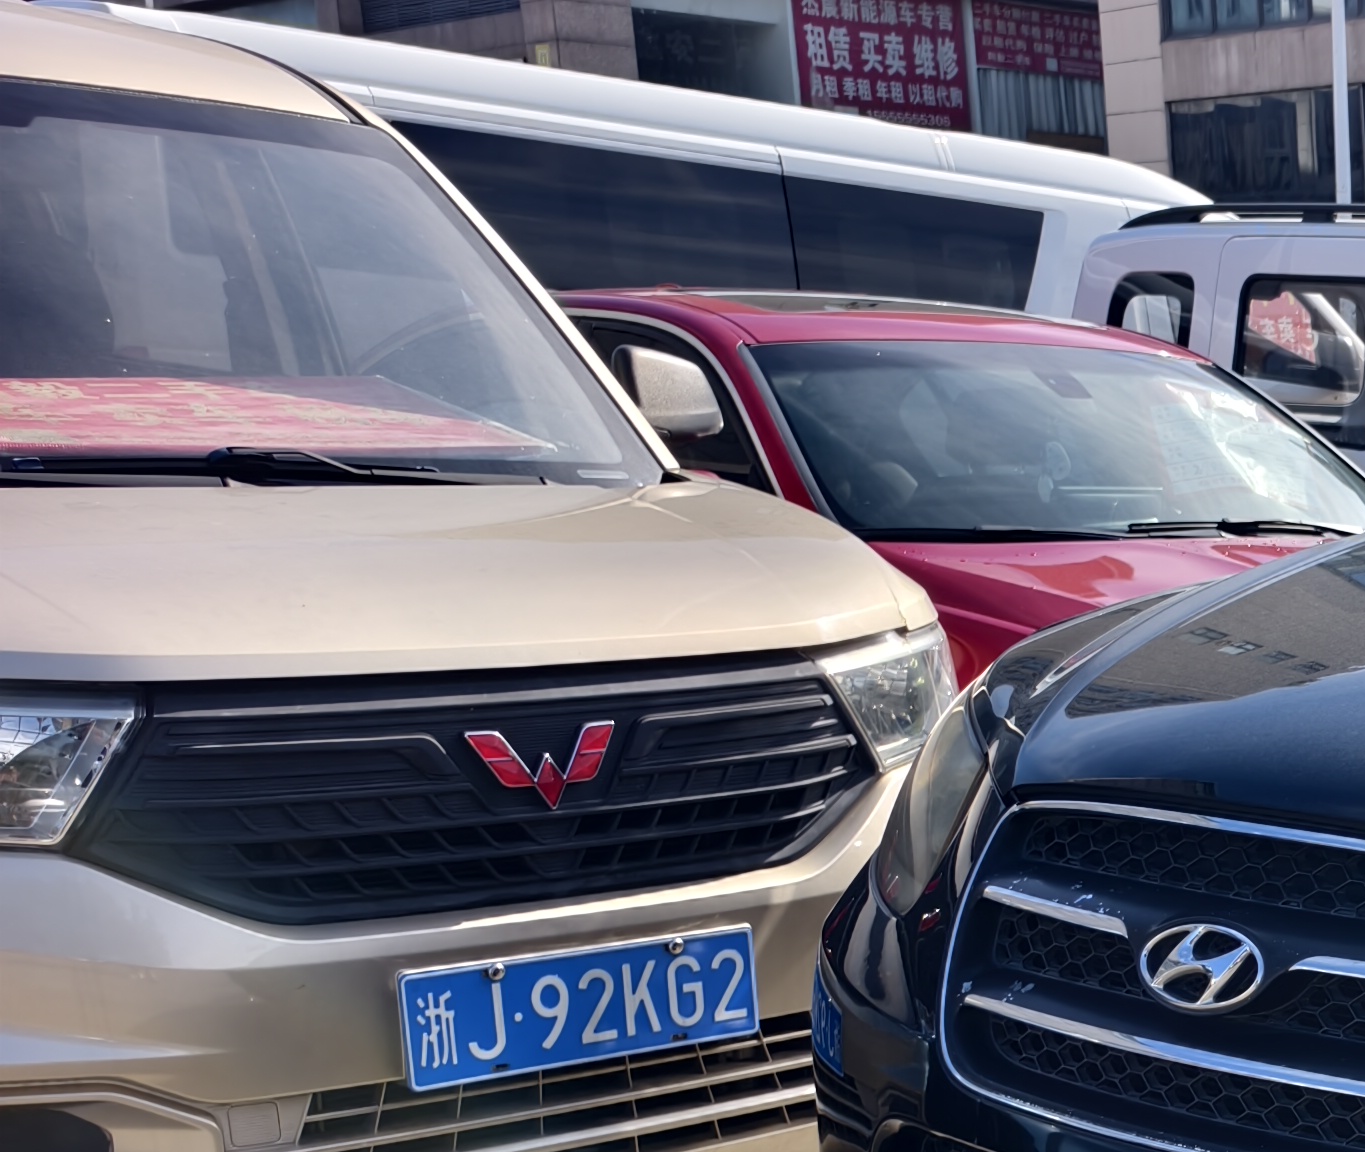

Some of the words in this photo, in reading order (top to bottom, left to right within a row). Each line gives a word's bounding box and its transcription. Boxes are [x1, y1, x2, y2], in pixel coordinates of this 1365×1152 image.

[803, 23, 852, 71] 租赁
[859, 31, 907, 76] 买卖
[912, 35, 959, 80] 维修
[417, 948, 749, 1069] 浙J·92KG2
